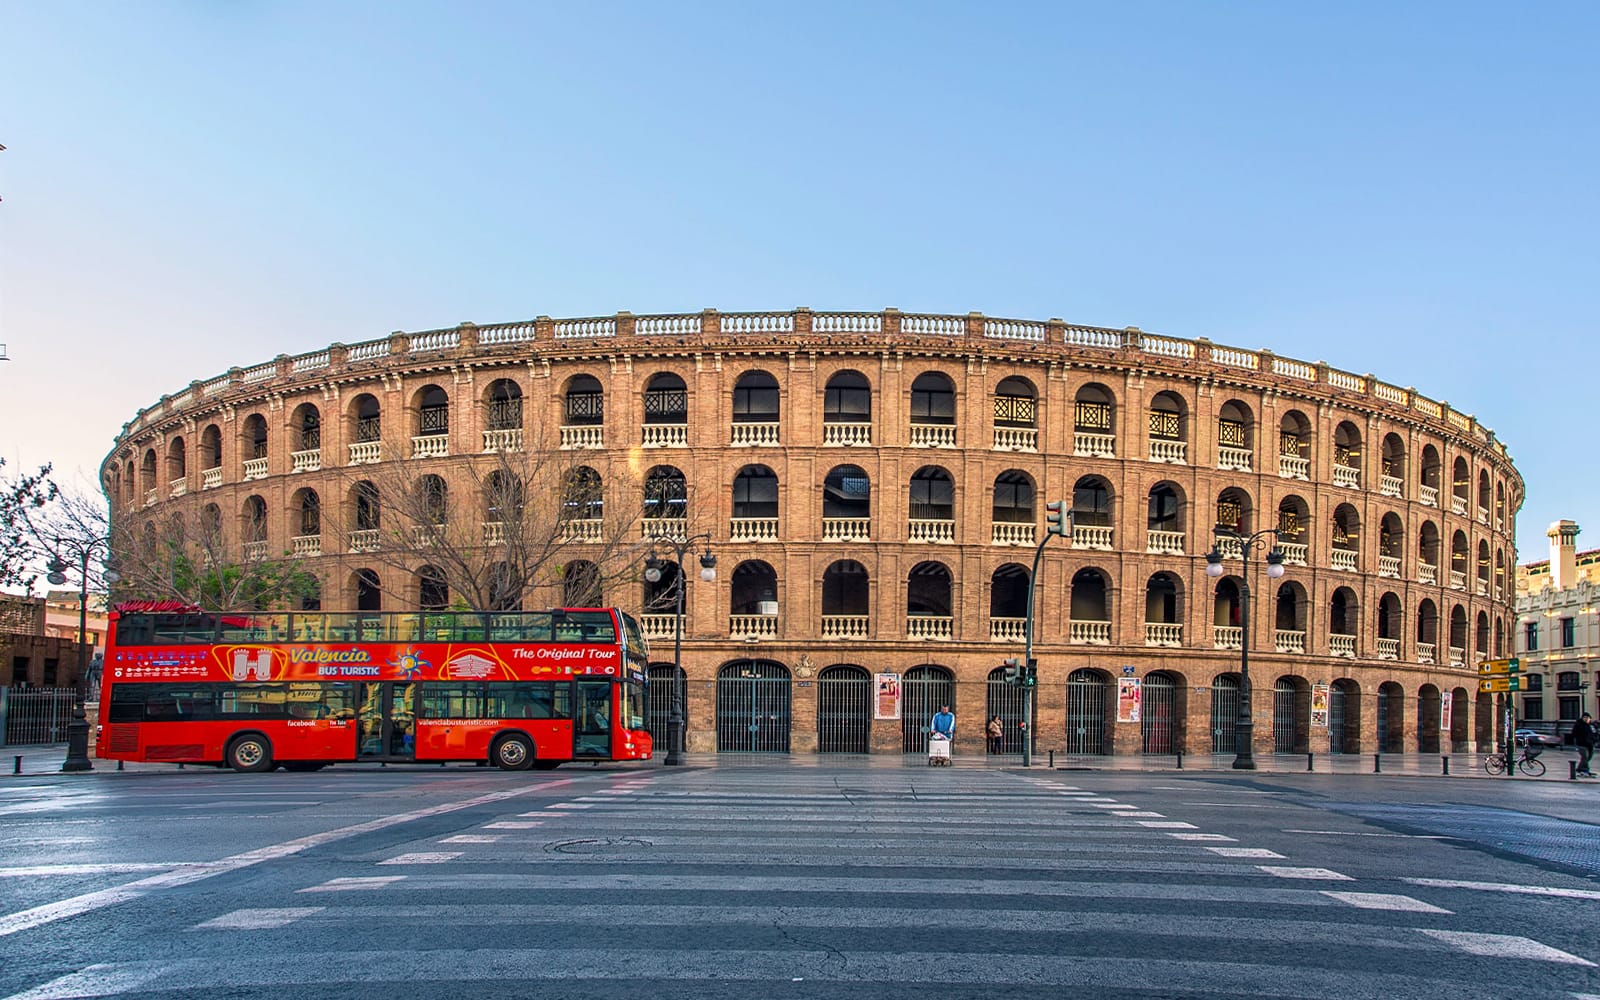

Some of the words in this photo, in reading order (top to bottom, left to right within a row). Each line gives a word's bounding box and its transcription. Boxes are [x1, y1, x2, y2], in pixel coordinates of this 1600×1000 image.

[290, 647, 371, 664] Valencia
[512, 648, 535, 659] The
[536, 648, 585, 661] Original
[588, 648, 616, 659] Tour
[318, 666, 337, 675] BUS
[339, 666, 380, 675] TURISTIC
[287, 719, 316, 727] facebook
[418, 718, 499, 726] valenciabusturistic.com
